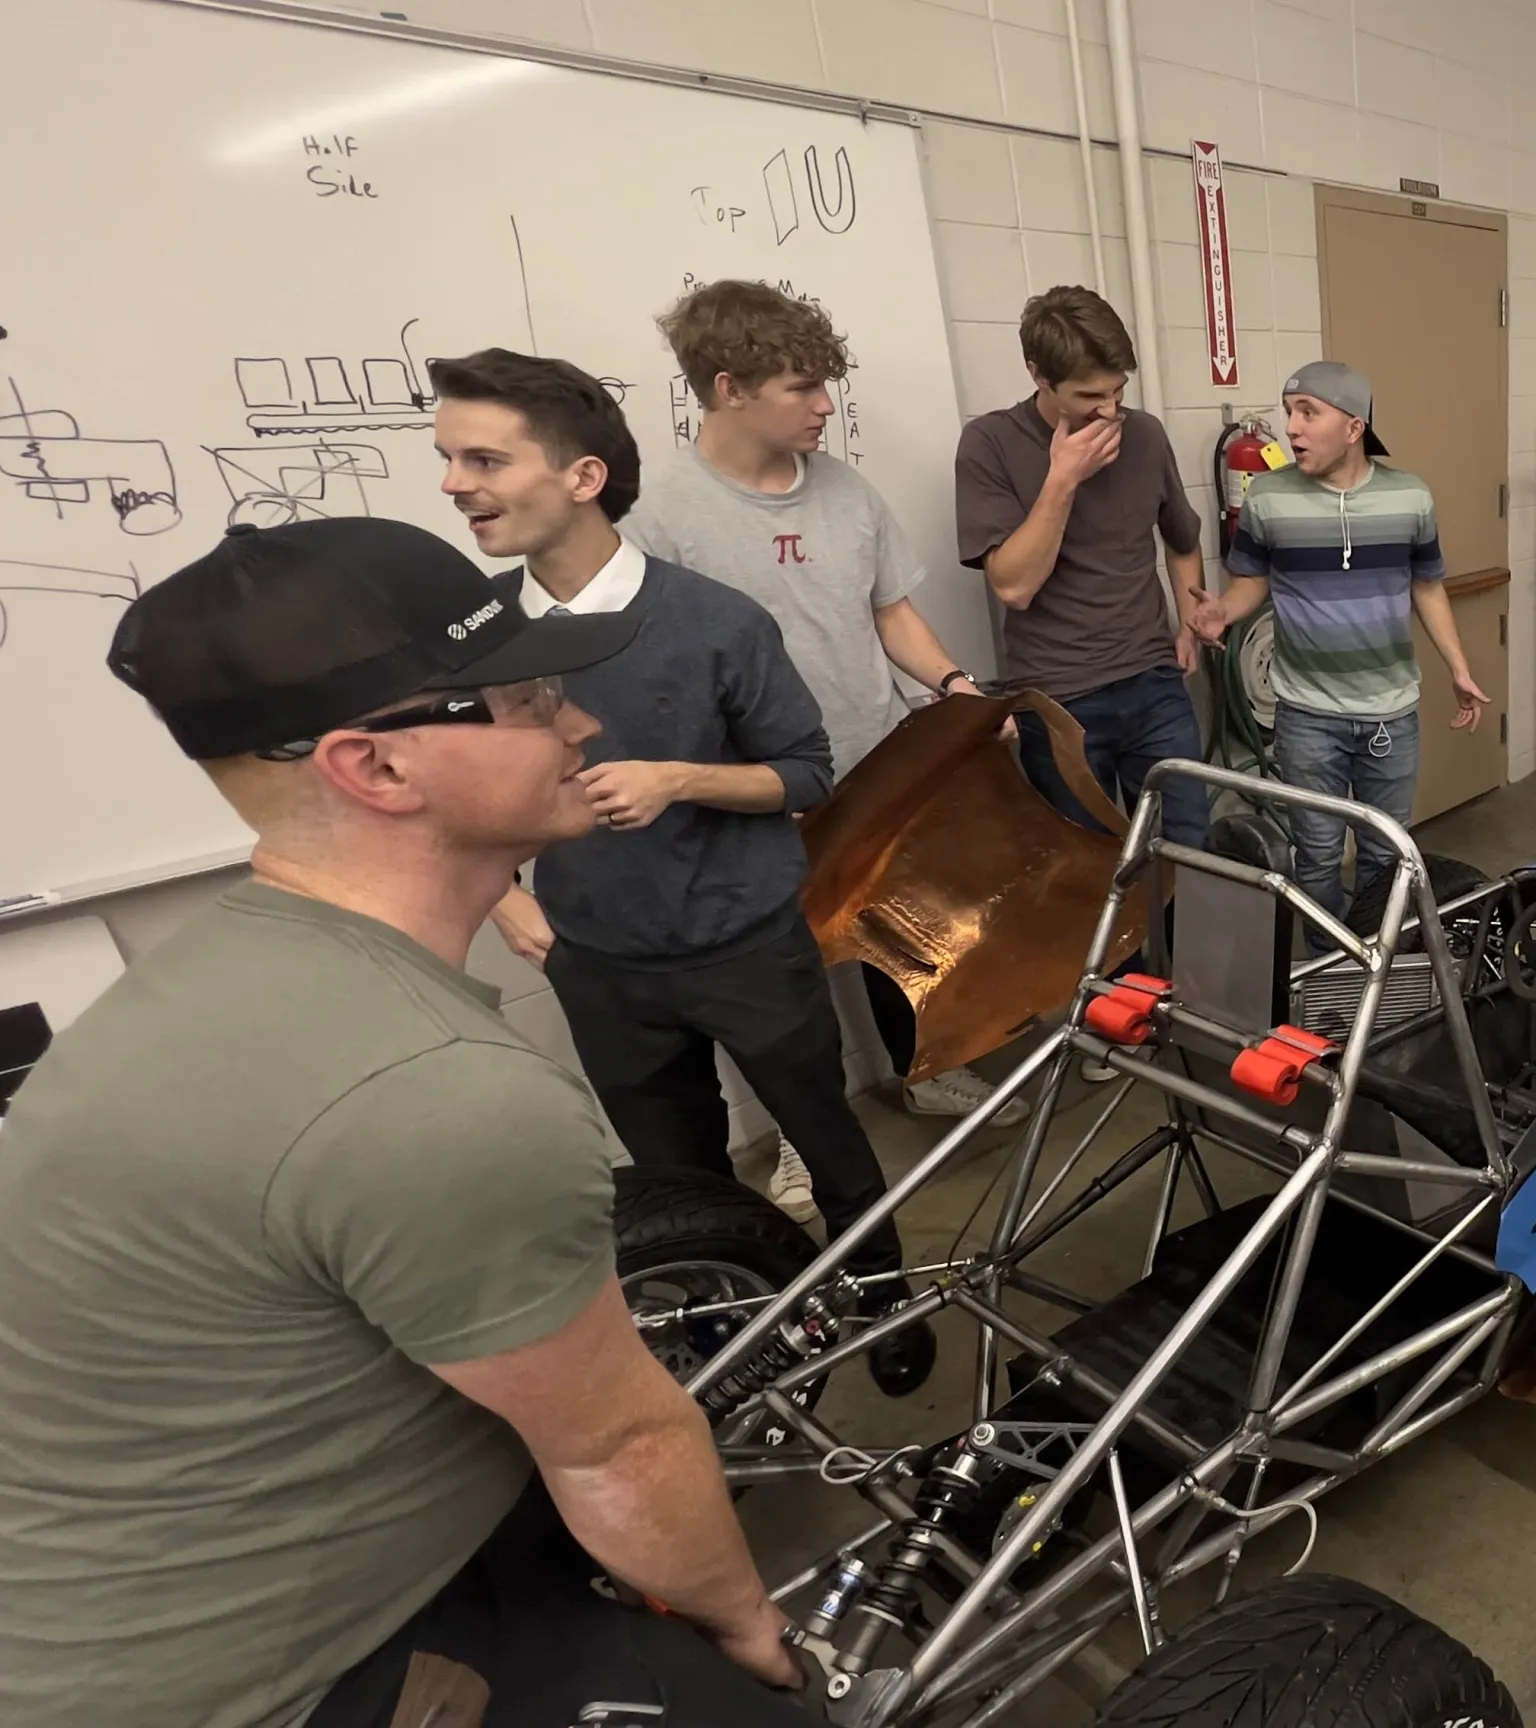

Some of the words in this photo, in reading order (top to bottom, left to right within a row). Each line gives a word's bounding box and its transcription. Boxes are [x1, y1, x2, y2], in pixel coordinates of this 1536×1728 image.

[1198, 160, 1219, 179] FIRE
[690, 184, 746, 233] Top
[1207, 185, 1228, 366] EXTINGUISHER
